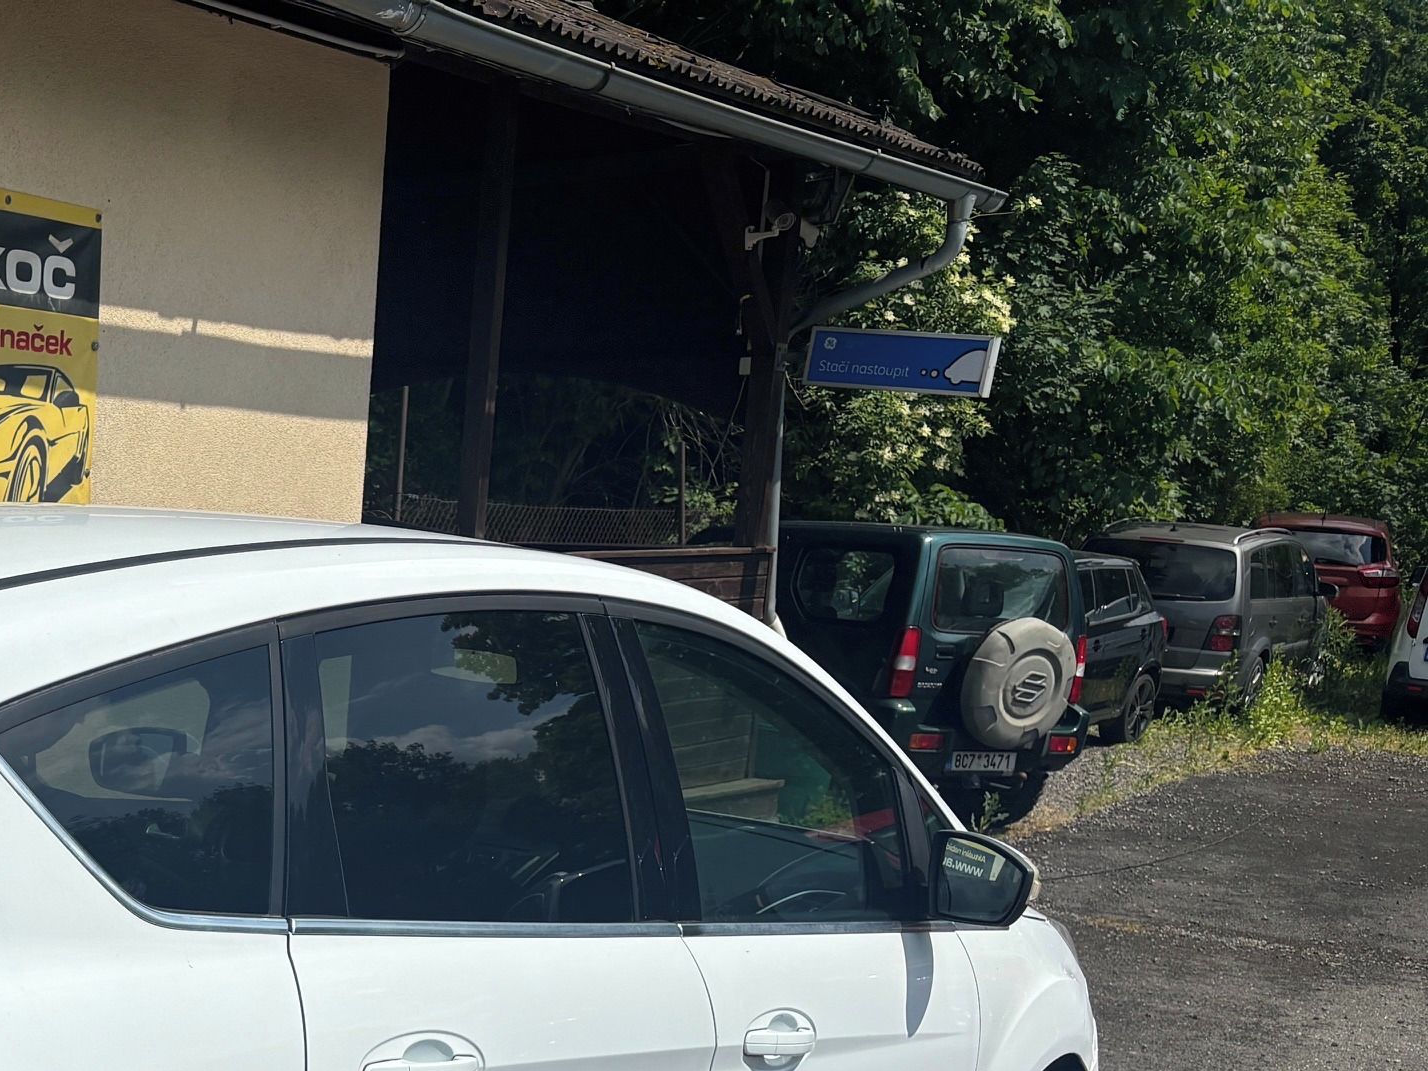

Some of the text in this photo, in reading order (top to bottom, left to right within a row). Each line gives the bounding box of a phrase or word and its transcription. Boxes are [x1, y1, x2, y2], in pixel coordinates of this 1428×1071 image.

[818, 359, 910, 379] Stačí nastoupit
[954, 753, 1011, 769] 8C7 3471
